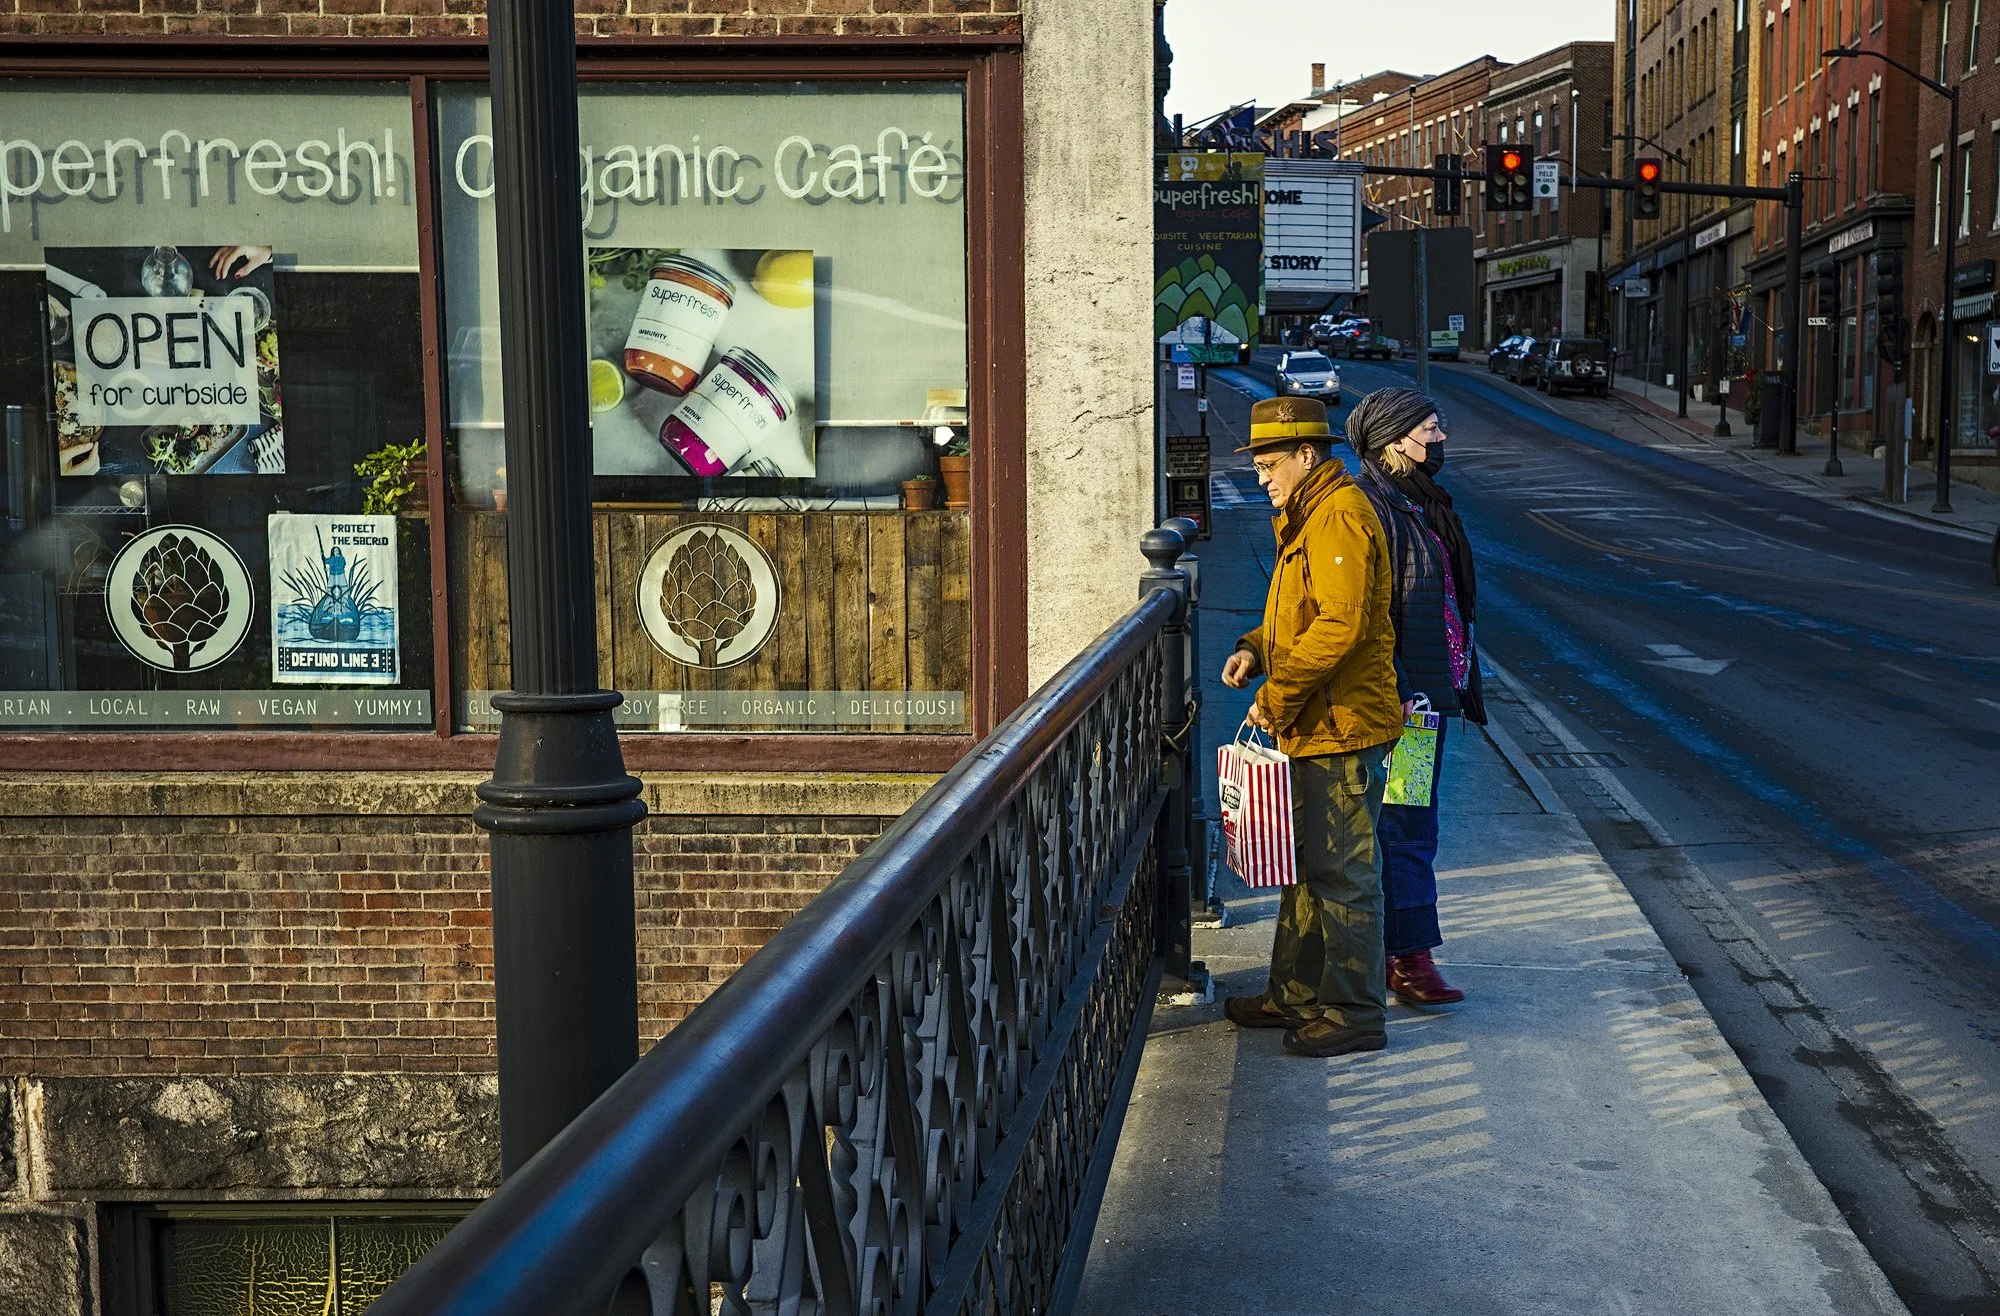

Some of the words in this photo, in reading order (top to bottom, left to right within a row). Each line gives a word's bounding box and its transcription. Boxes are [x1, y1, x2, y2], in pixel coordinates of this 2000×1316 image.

[455, 134, 744, 231] Oganic
[774, 126, 950, 200] Café
[1199, 232, 1258, 240] VEGETARIAN
[1177, 243, 1223, 251] CUISINE
[1270, 255, 1323, 270] STORY
[85, 311, 245, 371] OPEN
[638, 328, 668, 341] IMMUNITY
[89, 382, 133, 406] for
[143, 382, 248, 406] curbside
[331, 524, 376, 533] PROTECT
[332, 536, 351, 546] THE
[353, 536, 389, 546] SACRED
[291, 652, 339, 667] DEFUND
[342, 653, 369, 668] LINE
[371, 654, 380, 668] 3
[89, 698, 148, 716] LOCAL
[186, 698, 222, 716] RAW
[258, 699, 317, 716] VEGAN
[354, 699, 424, 717] YUMMY!
[741, 700, 817, 716] ORGANIC
[851, 700, 956, 716] DELICIOUS!
